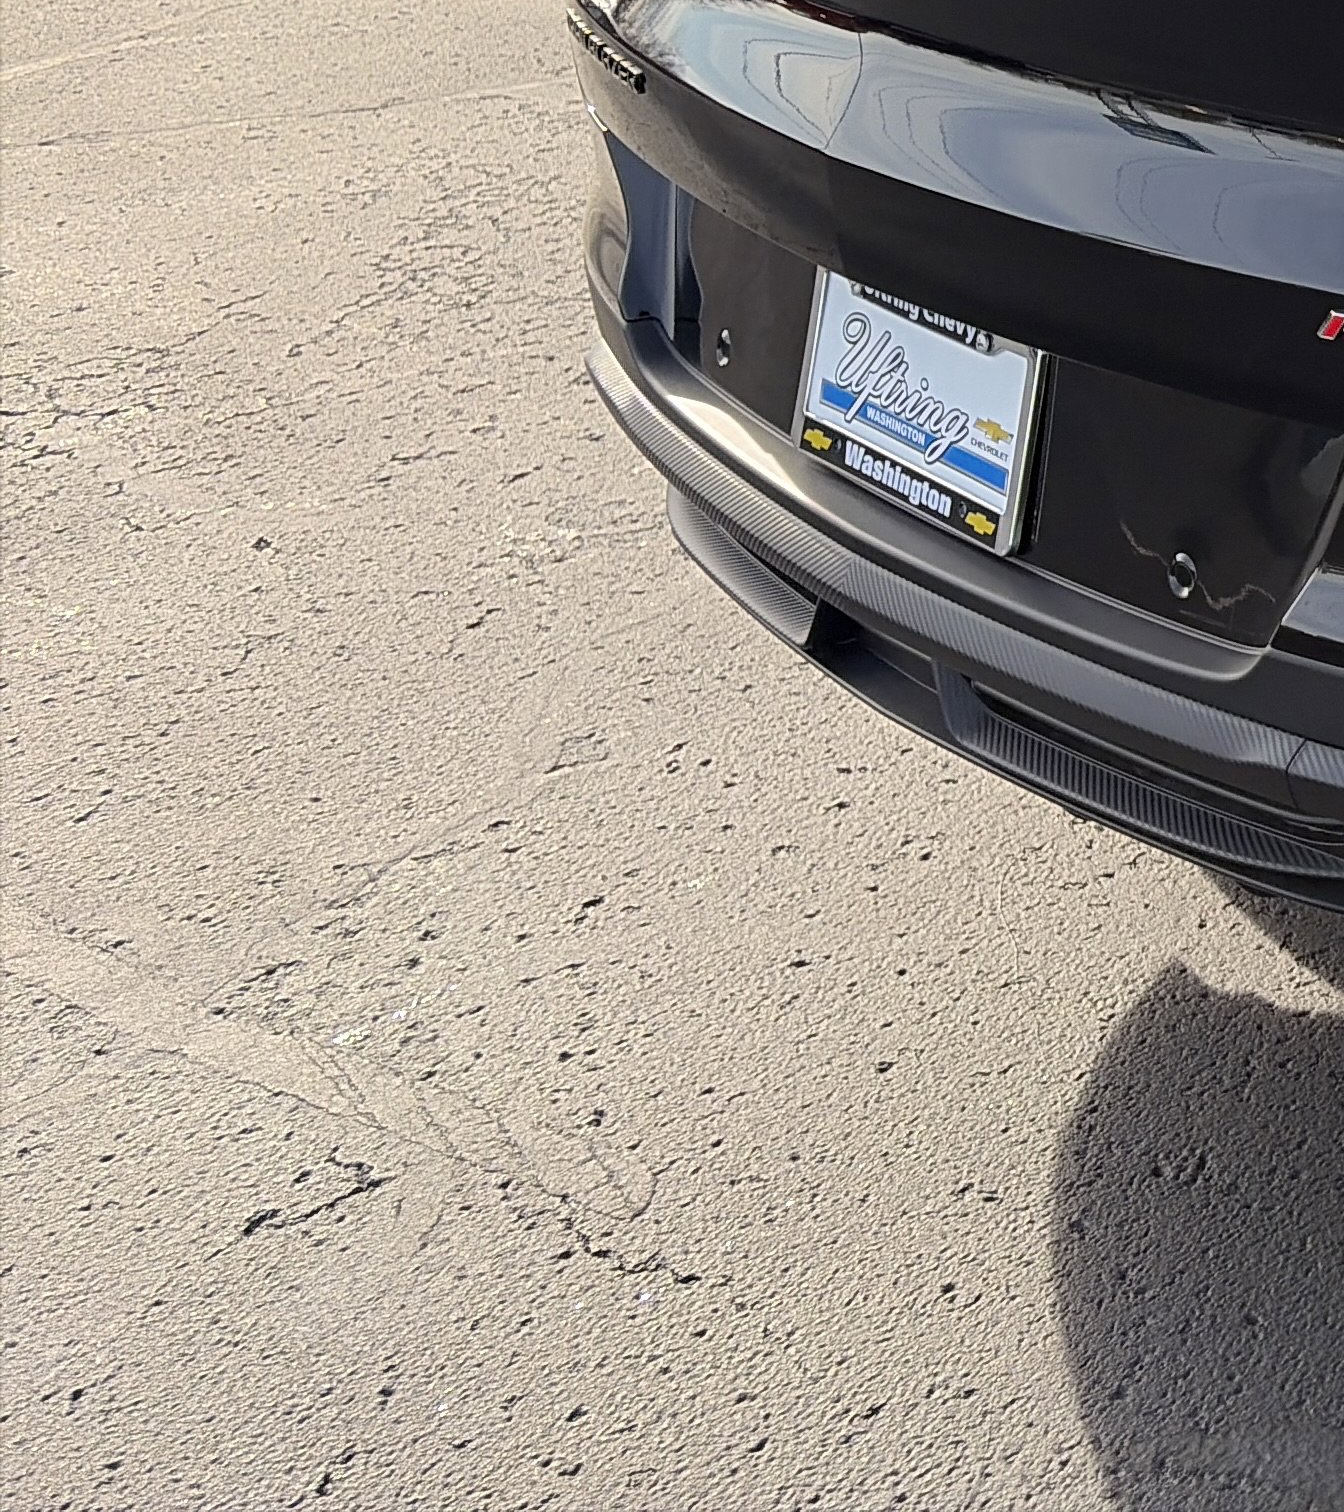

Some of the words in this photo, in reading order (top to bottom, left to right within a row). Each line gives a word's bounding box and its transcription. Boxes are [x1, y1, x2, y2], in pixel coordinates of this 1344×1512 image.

[835, 312, 970, 464] Uftring
[866, 405, 926, 446] WASHINGTON
[970, 437, 1009, 463] CHEVROLET
[844, 440, 953, 518] Washington
